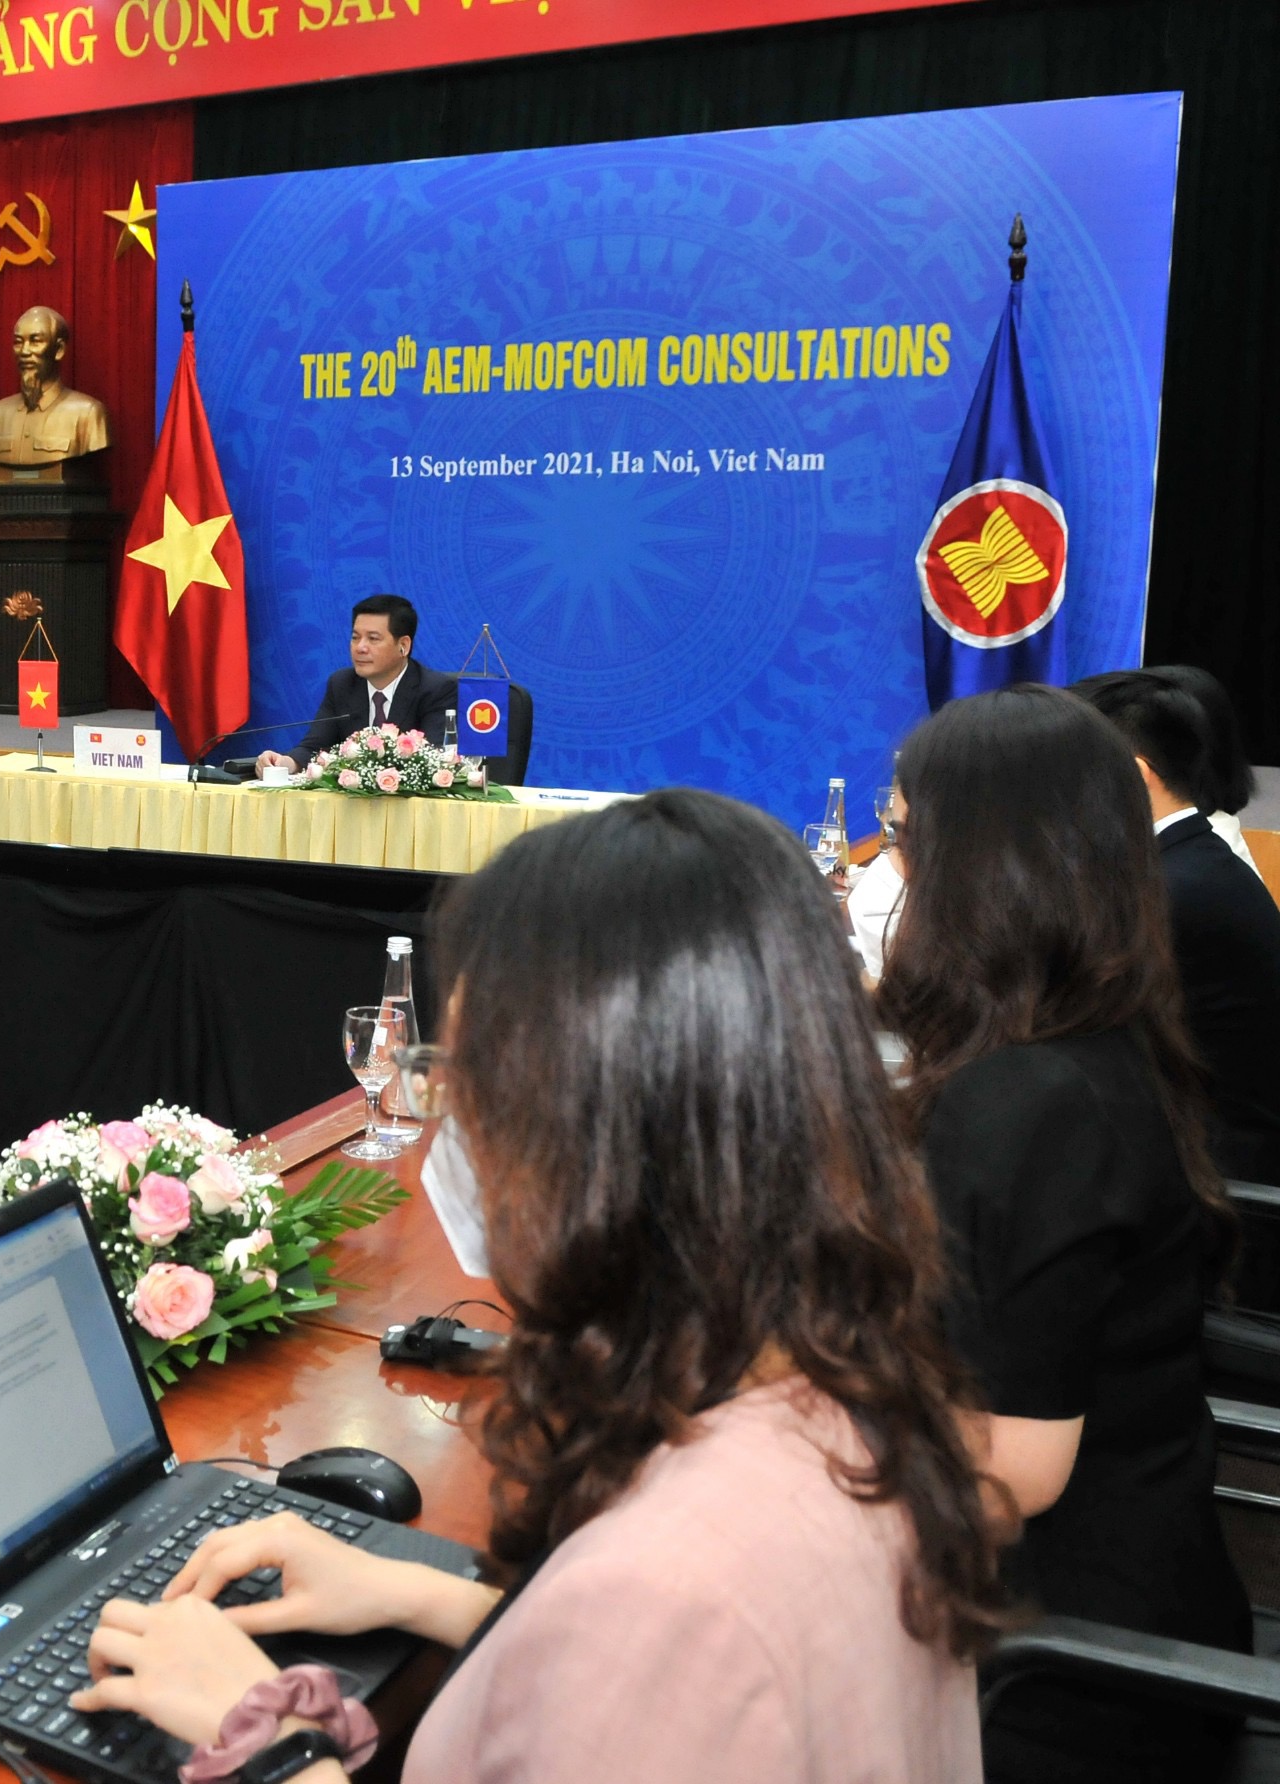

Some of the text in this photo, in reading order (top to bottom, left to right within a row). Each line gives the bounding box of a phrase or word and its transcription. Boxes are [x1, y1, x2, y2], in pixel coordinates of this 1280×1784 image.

[300, 322, 951, 399] THE 20th AEM-MOFCOM CONSULTATIONS
[390, 447, 825, 483] 13 September 2021, Ha Noi, Viet Nam
[91, 753, 143, 768] VIET NAM
